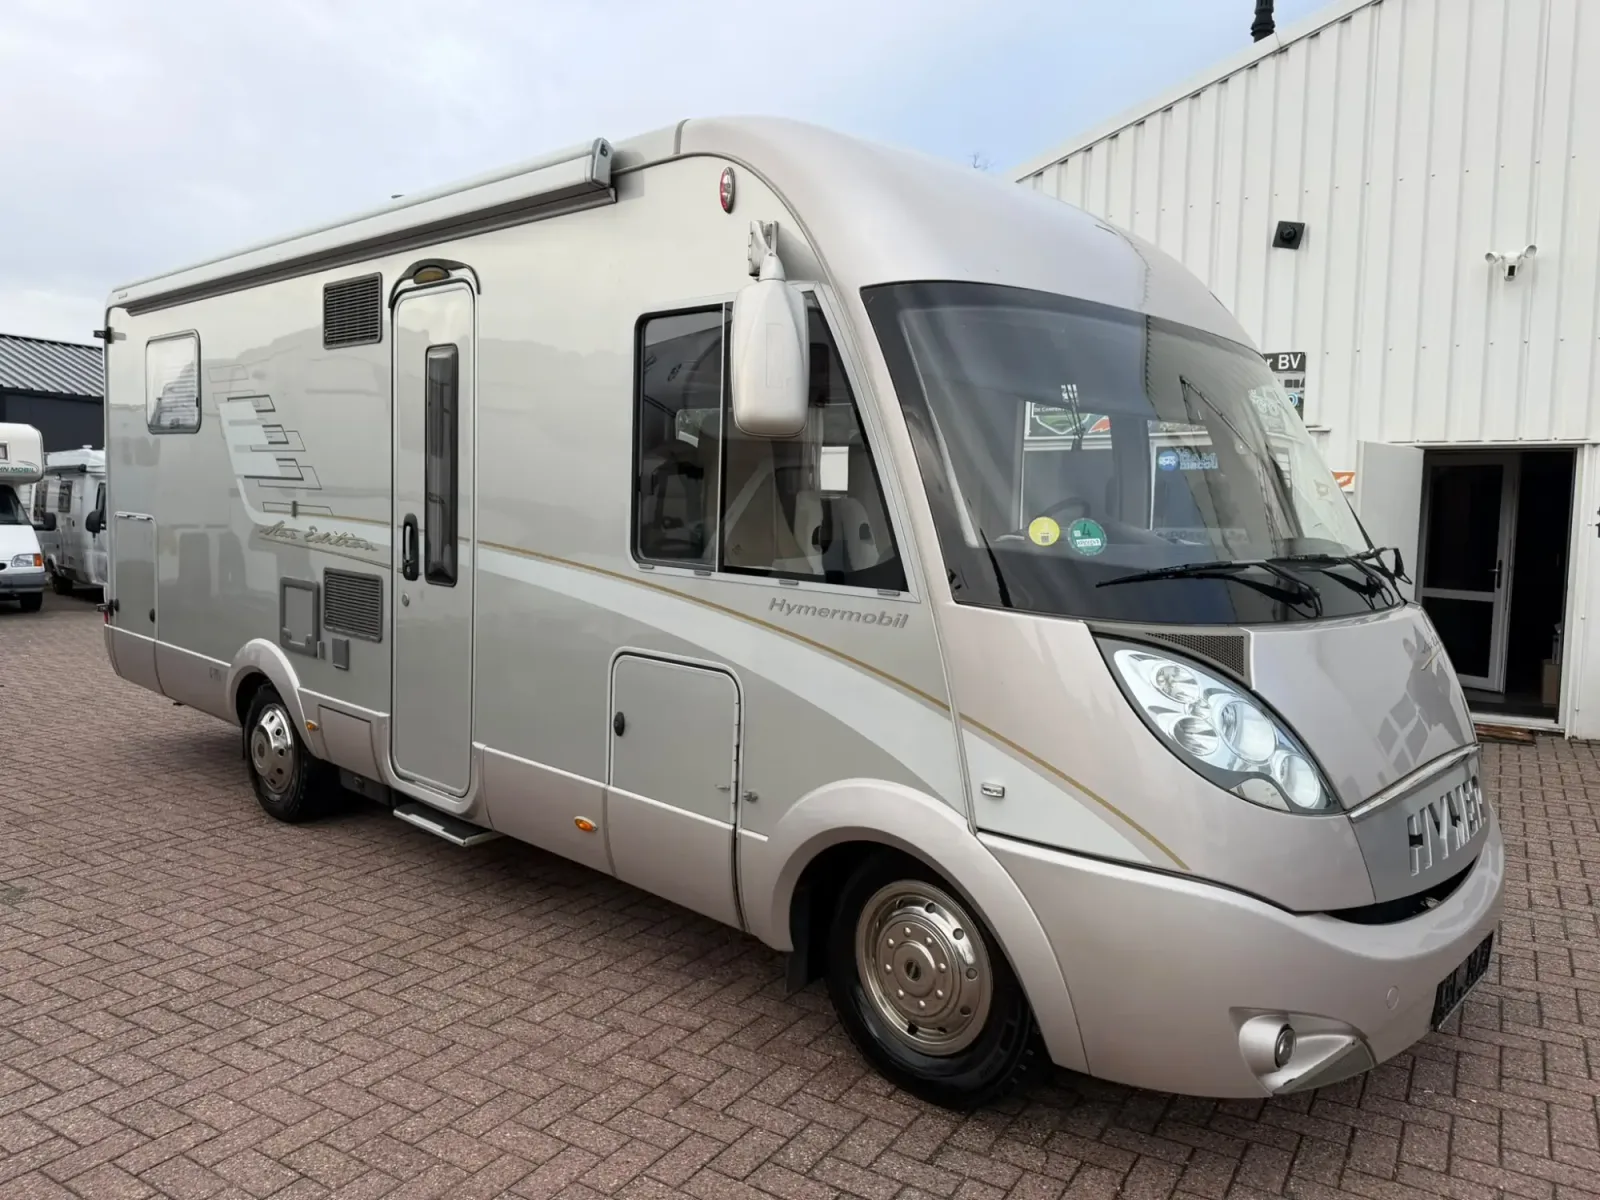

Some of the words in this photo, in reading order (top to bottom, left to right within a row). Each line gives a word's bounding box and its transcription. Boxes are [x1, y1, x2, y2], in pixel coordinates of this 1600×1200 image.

[1278, 353, 1302, 370] BV
[768, 597, 909, 629] Hymermobil
[1406, 775, 1487, 877] HYMER
